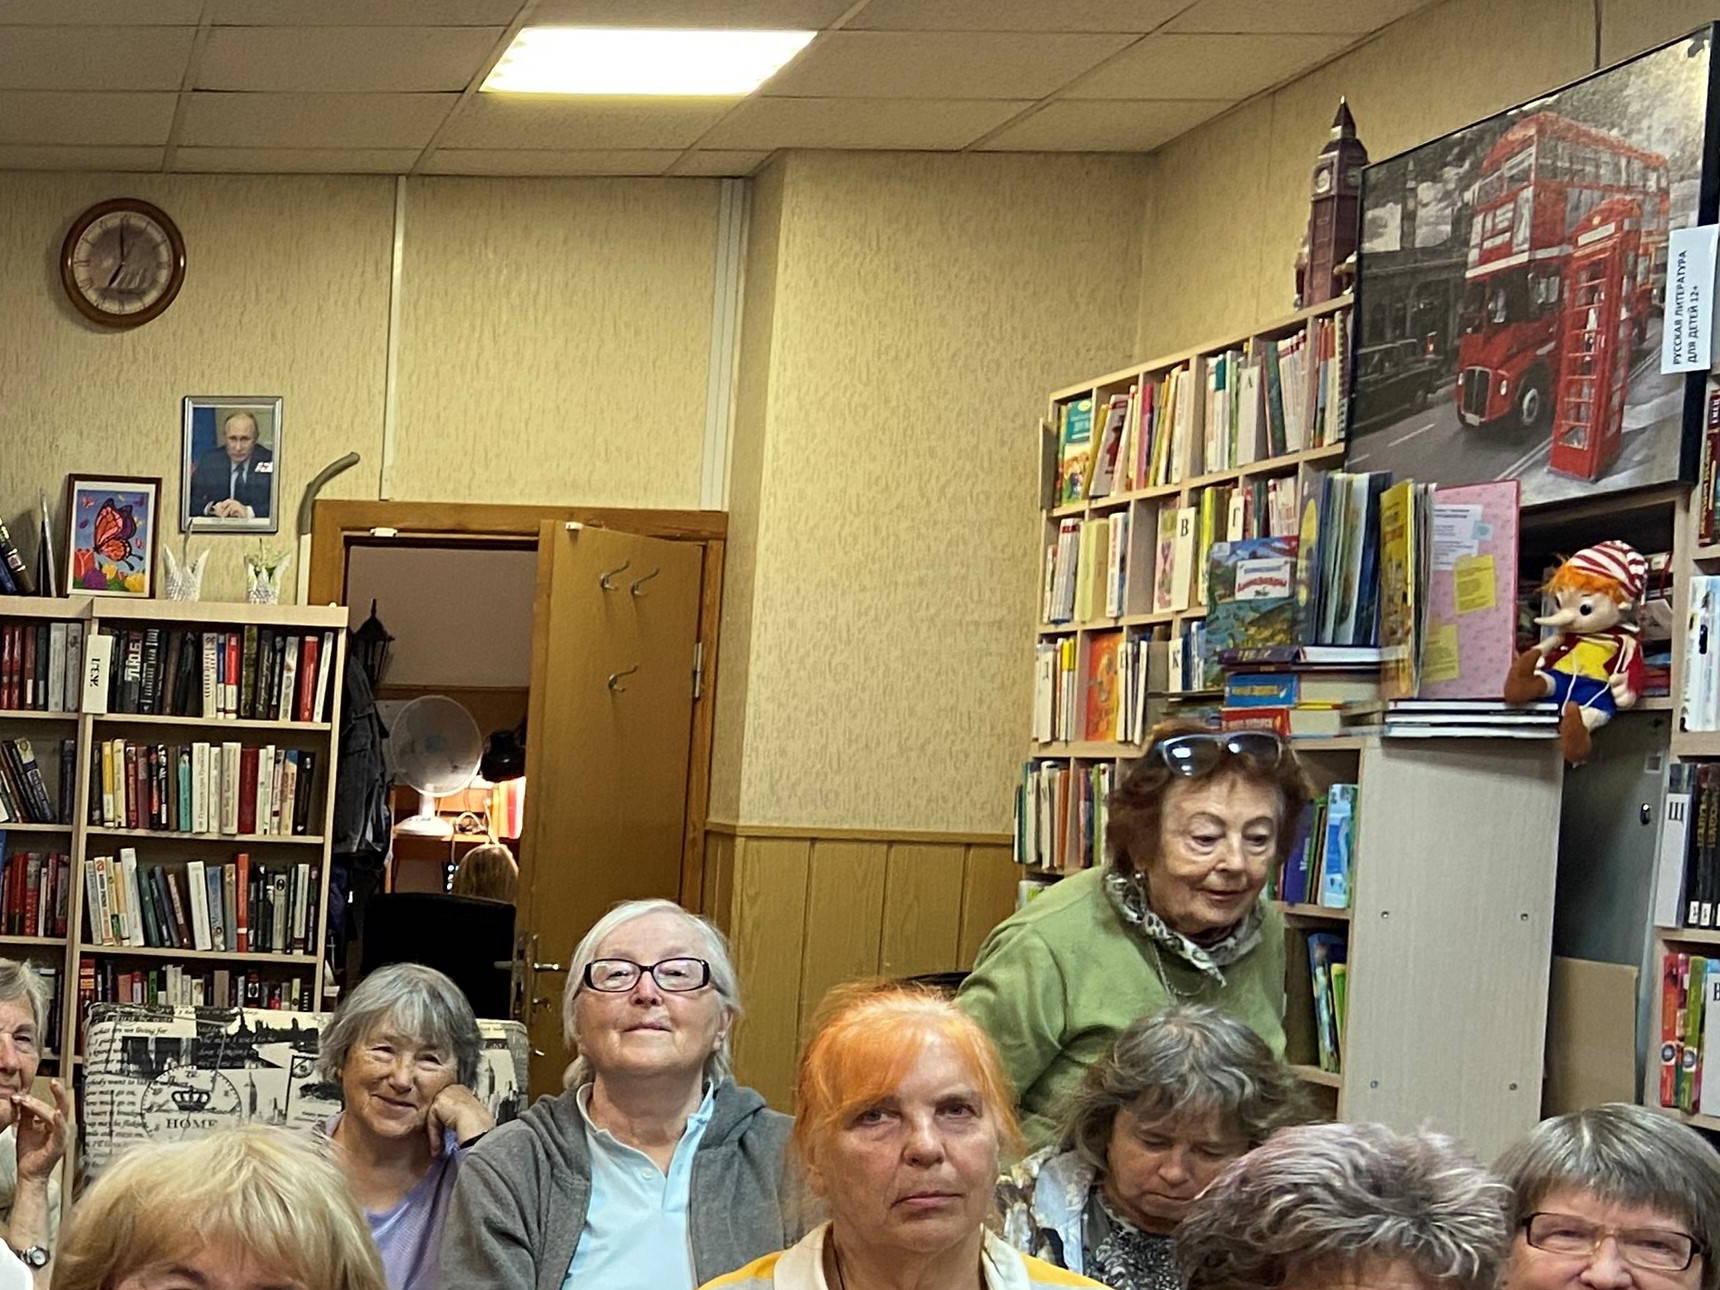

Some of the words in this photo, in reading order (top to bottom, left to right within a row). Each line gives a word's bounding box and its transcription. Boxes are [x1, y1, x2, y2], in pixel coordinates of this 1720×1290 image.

[1674, 250, 1689, 318] ЛИТЕРАТУРА
[1689, 285, 1700, 304] 12+
[1687, 305, 1699, 339] ДЕТЕЙ
[1672, 319, 1684, 365] РУССКАЯ
[1687, 341, 1698, 364] ДЛЯ
[1180, 518, 1189, 538] В
[1231, 507, 1241, 528] Г
[88, 657, 101, 688] ЖЗЛ
[166, 1118, 219, 1129] HOME
